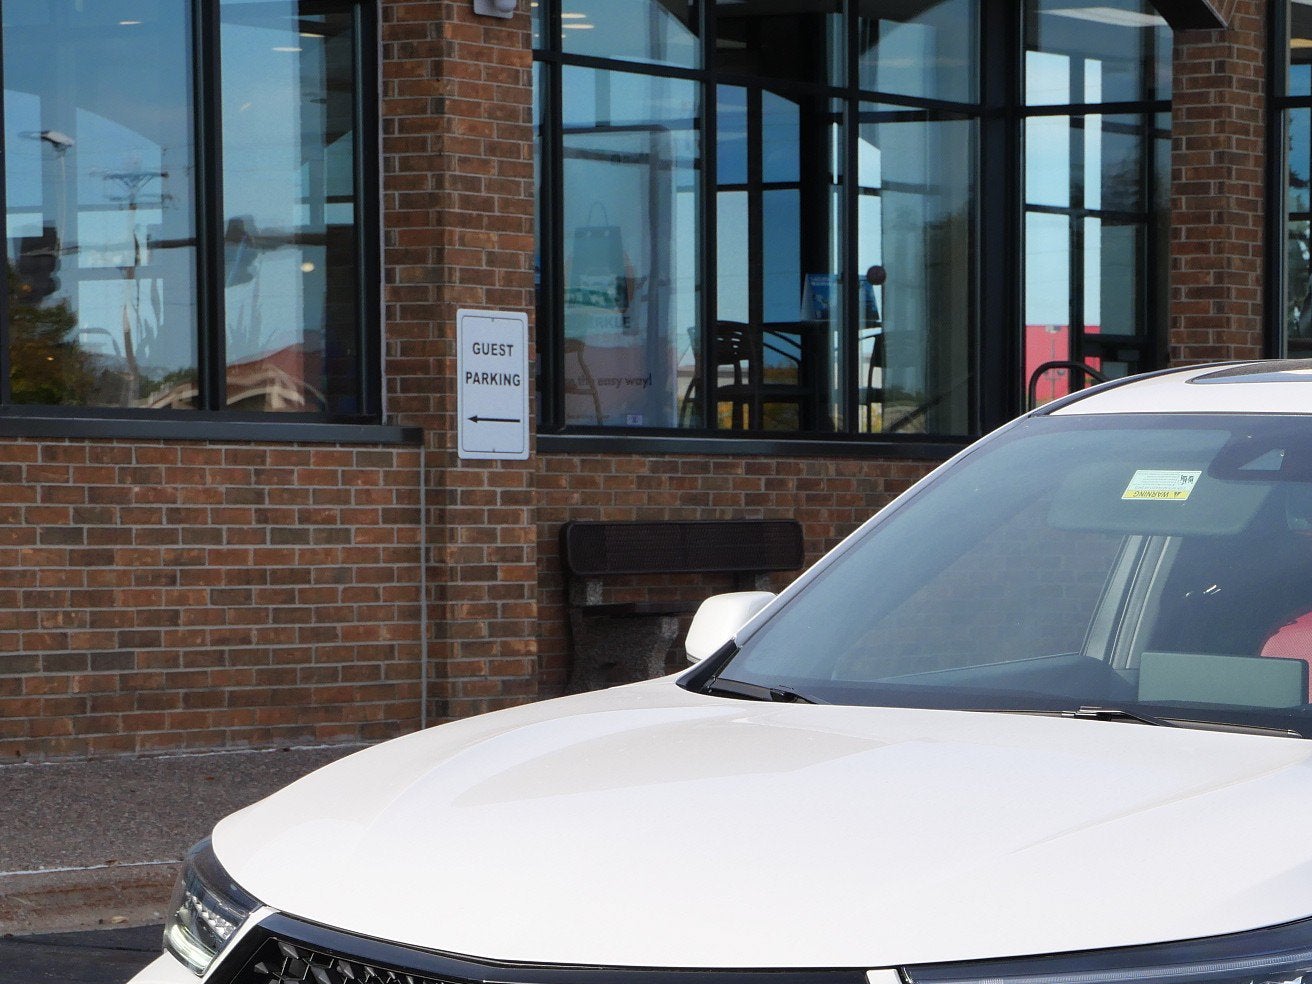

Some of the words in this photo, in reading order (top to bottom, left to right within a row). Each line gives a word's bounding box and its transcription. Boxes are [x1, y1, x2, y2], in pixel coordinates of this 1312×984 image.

[472, 342, 514, 357] GUEST
[465, 371, 521, 387] PARKING
[1132, 490, 1170, 498] WARNING
